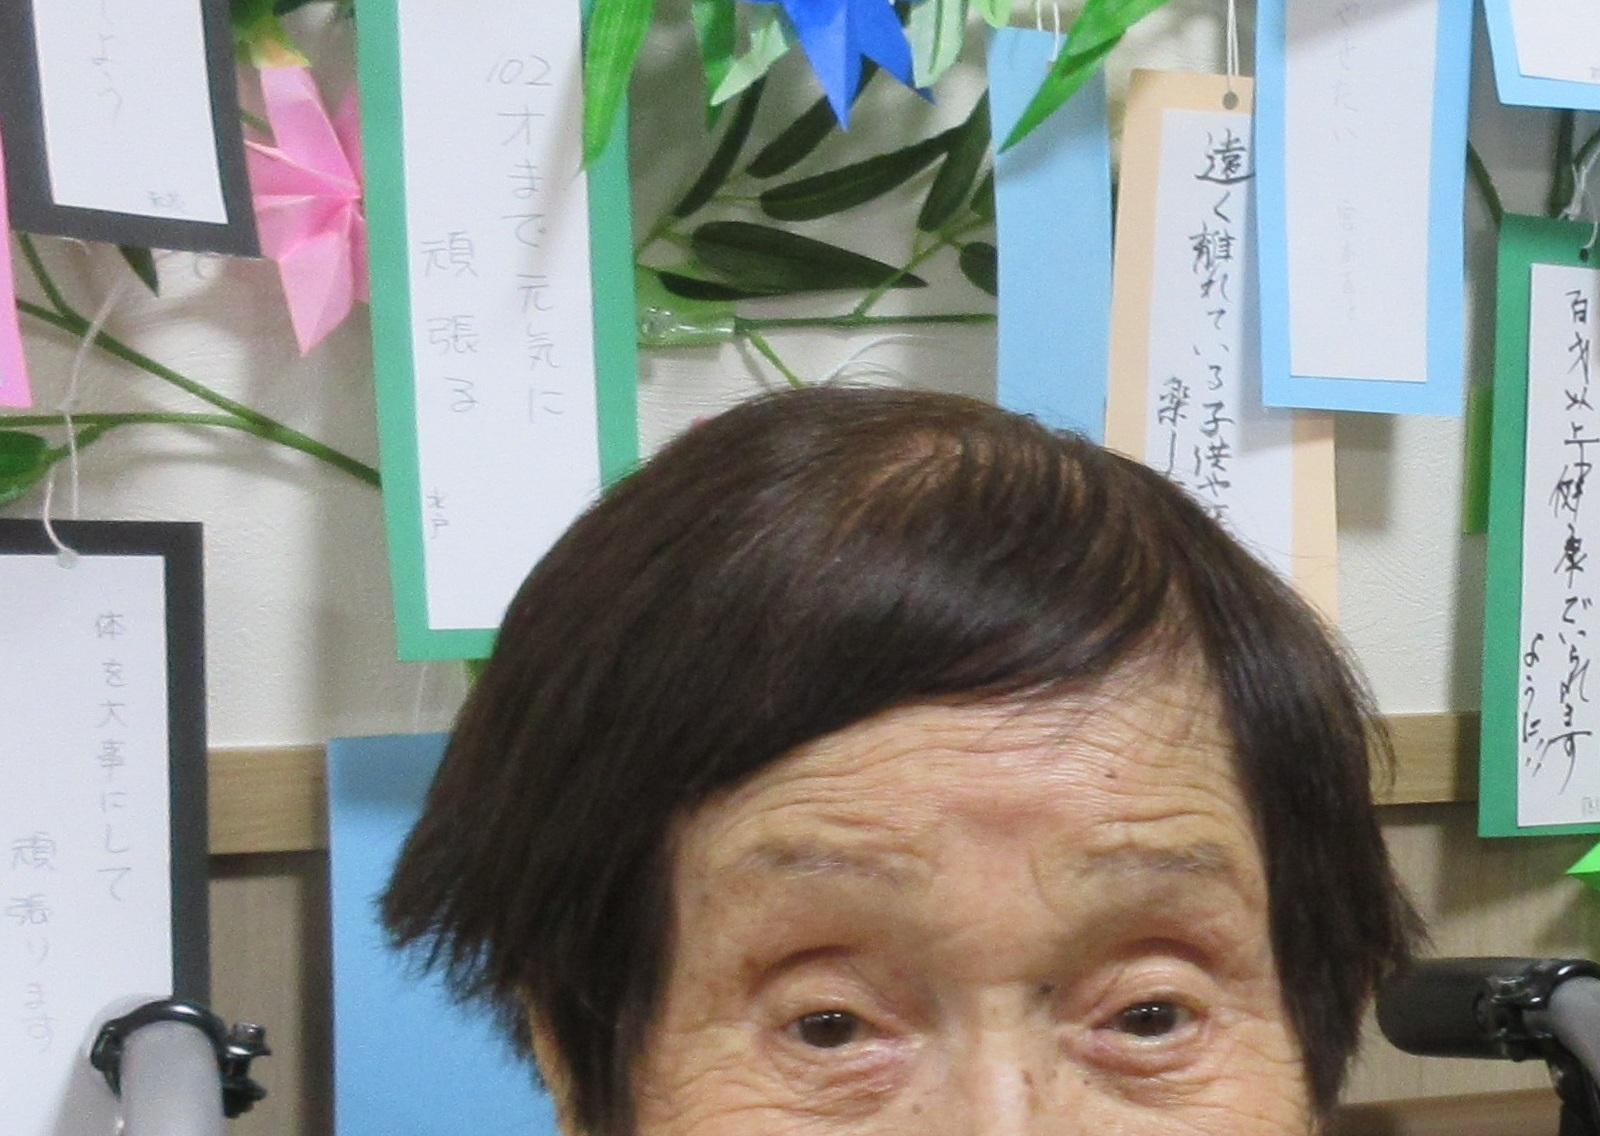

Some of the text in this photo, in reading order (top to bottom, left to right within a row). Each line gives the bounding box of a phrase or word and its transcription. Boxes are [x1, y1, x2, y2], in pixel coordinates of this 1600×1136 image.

[419, 231, 482, 415] 頑張る
[95, 610, 132, 902] 体を大事にして
